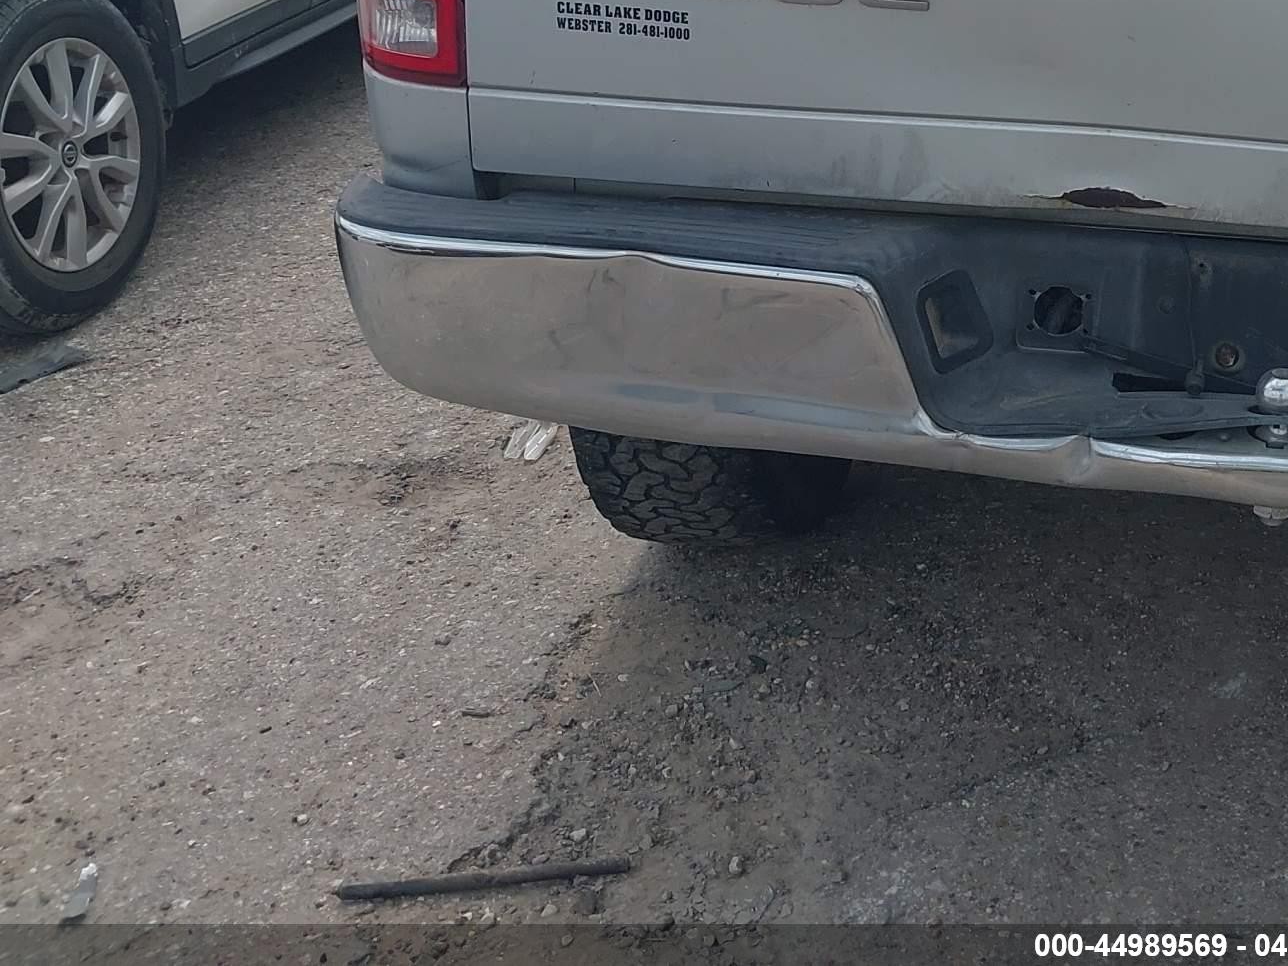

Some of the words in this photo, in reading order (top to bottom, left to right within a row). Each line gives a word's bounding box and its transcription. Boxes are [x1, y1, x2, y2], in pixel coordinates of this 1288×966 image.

[556, 1, 601, 17] CLEAR
[605, 5, 641, 20] LAKE
[644, 8, 689, 25] DODGE
[556, 16, 612, 33] WEBSTER
[618, 22, 691, 41] 281-481-1000
